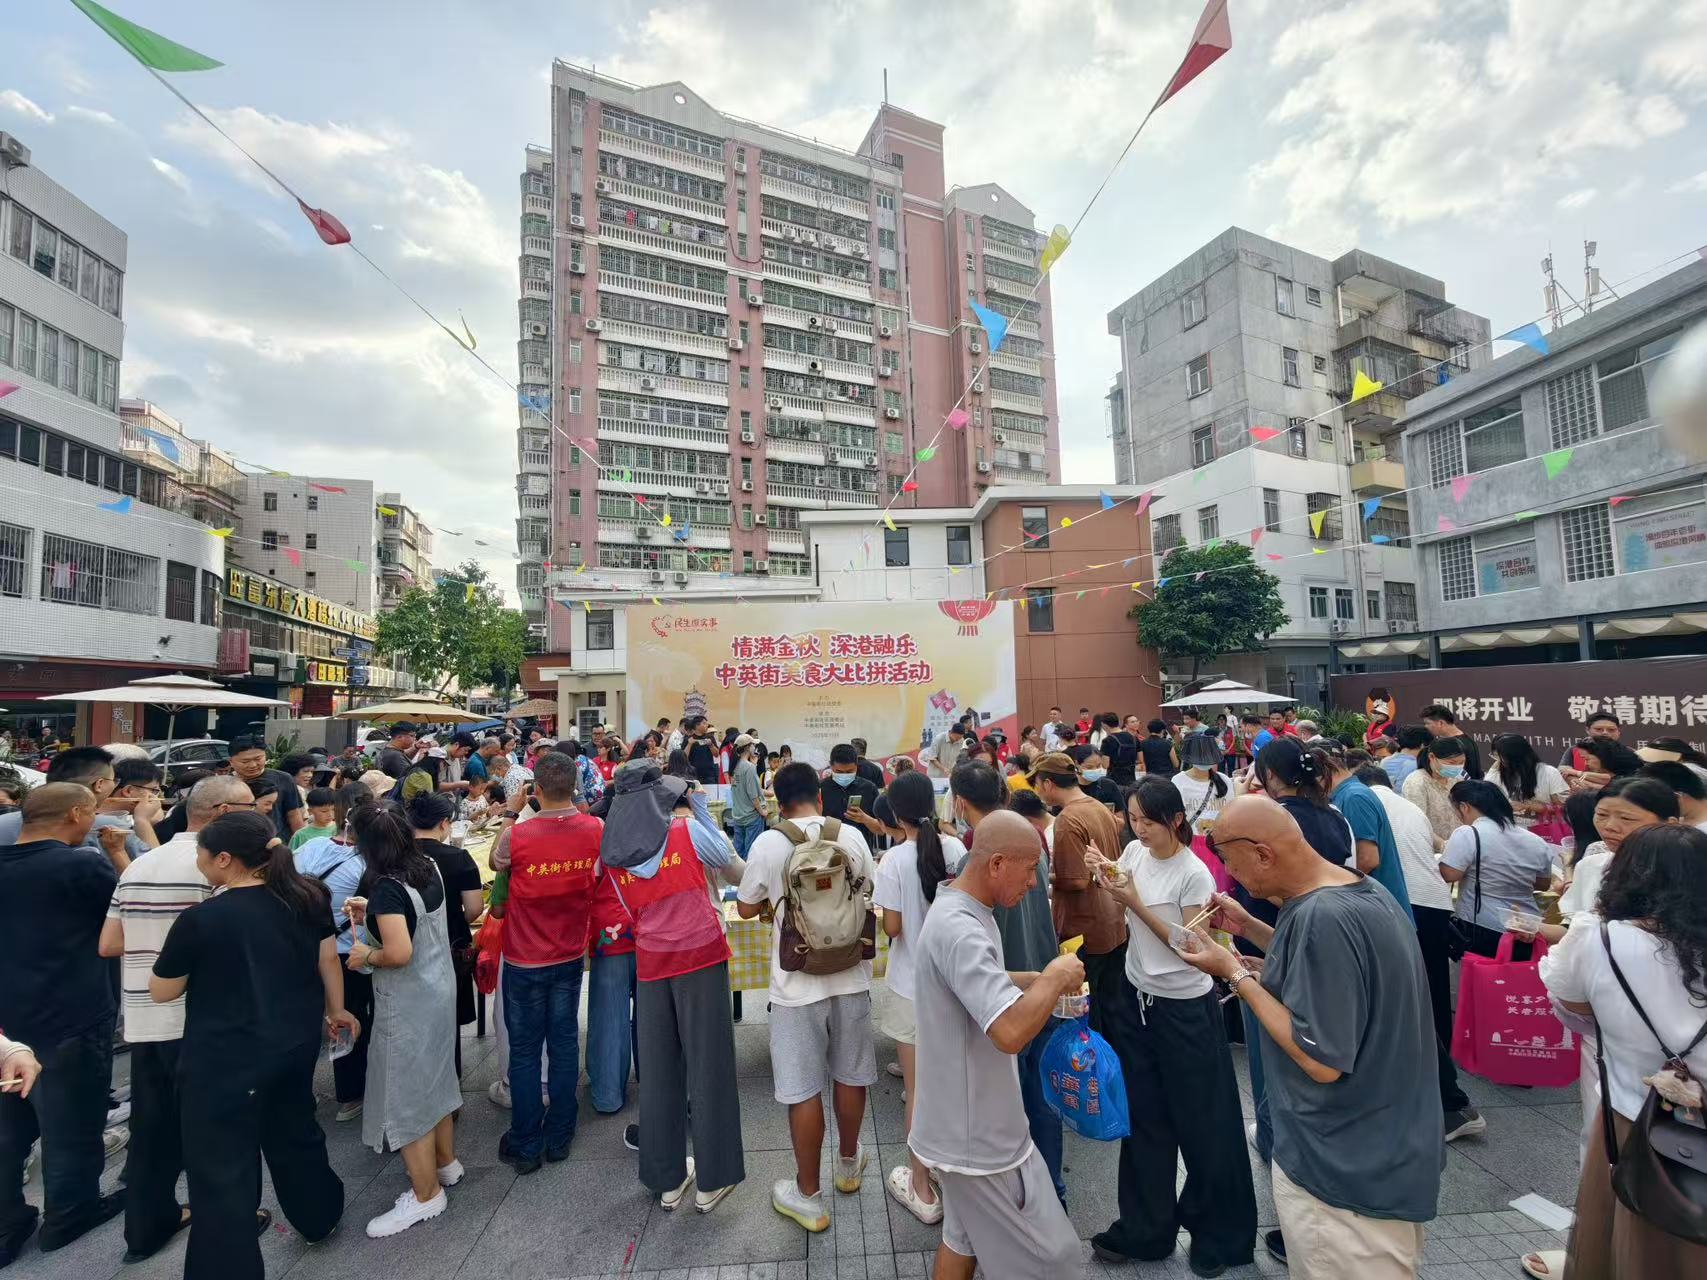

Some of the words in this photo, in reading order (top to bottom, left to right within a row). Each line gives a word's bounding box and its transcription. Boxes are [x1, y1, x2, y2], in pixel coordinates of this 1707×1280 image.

[732, 633, 821, 659] 情满金秋
[830, 633, 918, 658] 深港融乐
[714, 659, 933, 688] 中英街美食大比拼活动
[1567, 695, 1707, 726] 敬请期待
[1523, 736, 1554, 747] ITH
[526, 857, 593, 877] 中英街管理局
[1505, 994, 1546, 1004] 悦享夕
